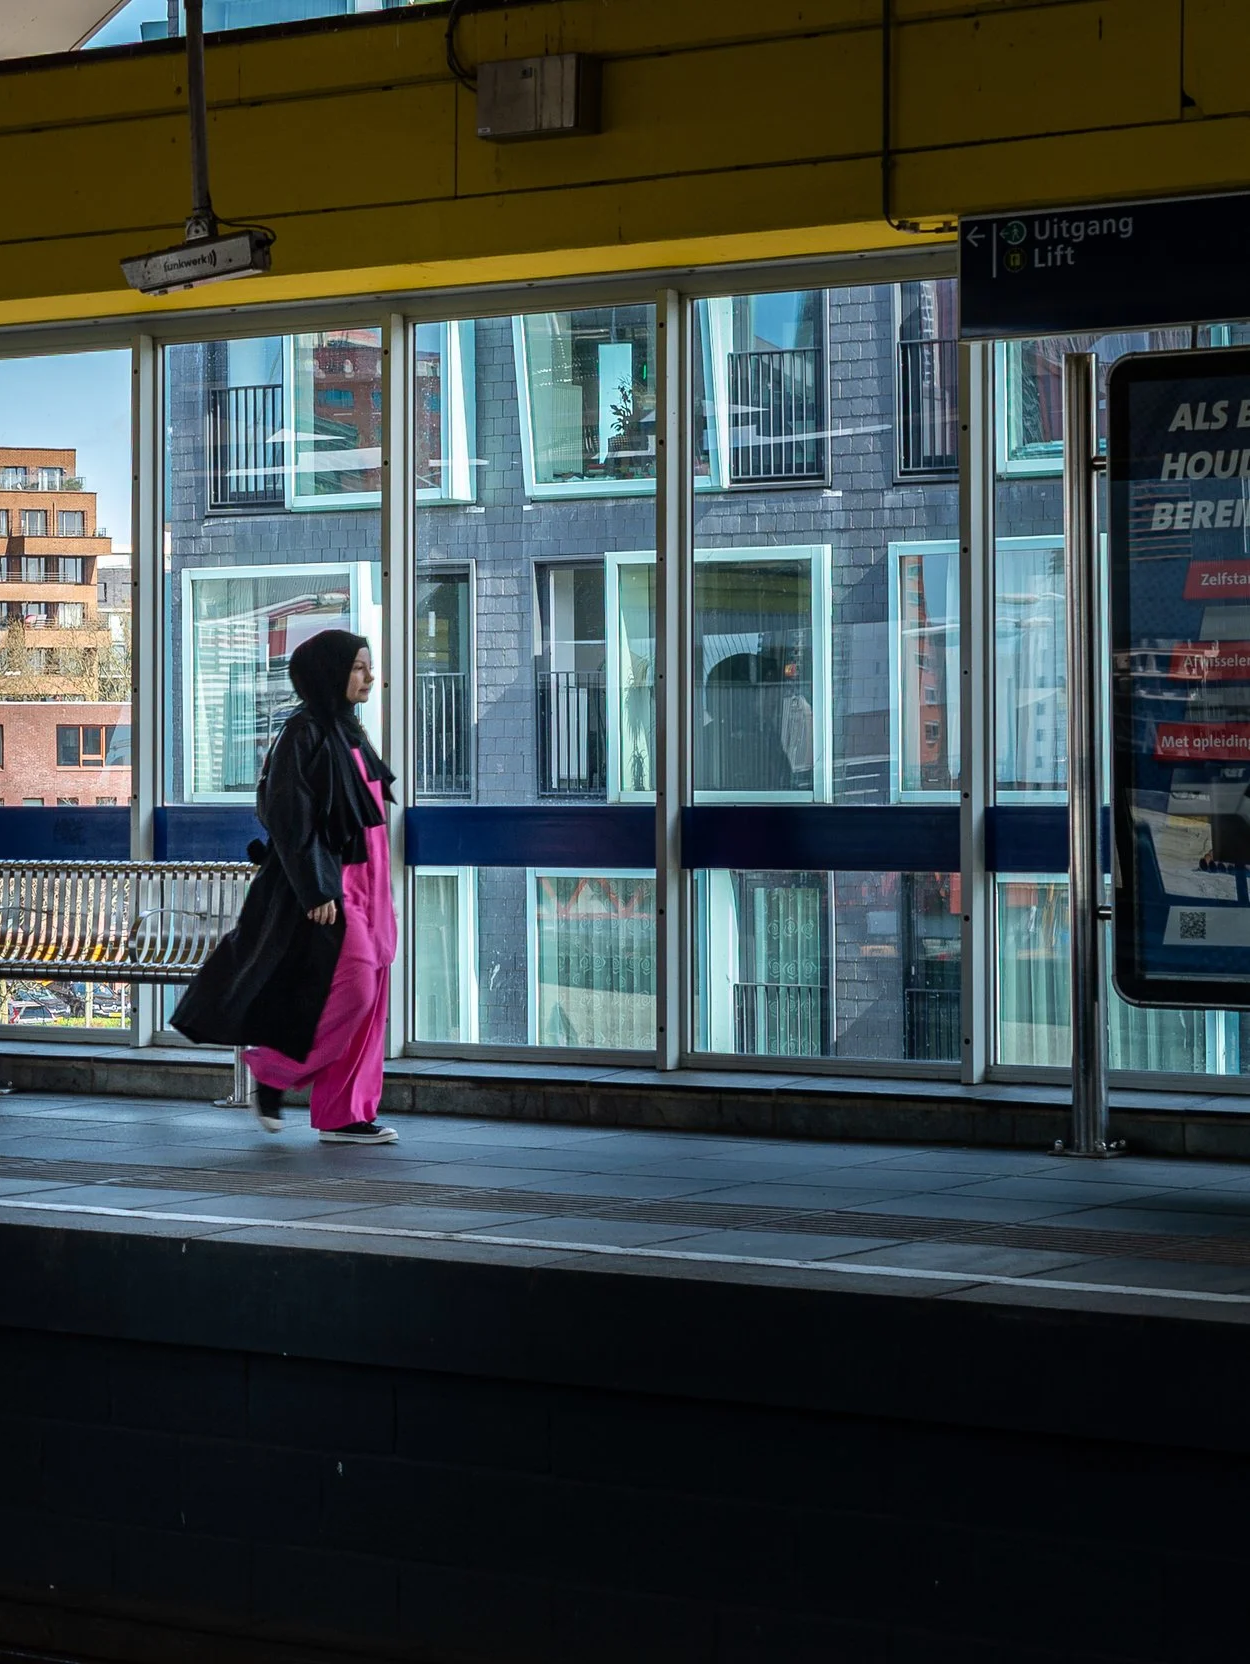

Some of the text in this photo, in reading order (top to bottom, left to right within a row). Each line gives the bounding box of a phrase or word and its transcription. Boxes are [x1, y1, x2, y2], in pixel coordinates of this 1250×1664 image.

[1033, 215, 1135, 243] Uitgang
[163, 254, 208, 273] funkwerk
[1033, 244, 1076, 269] Lift
[1167, 399, 1230, 432] ALS
[1150, 498, 1250, 531] BEREI
[1161, 735, 1190, 748] Met
